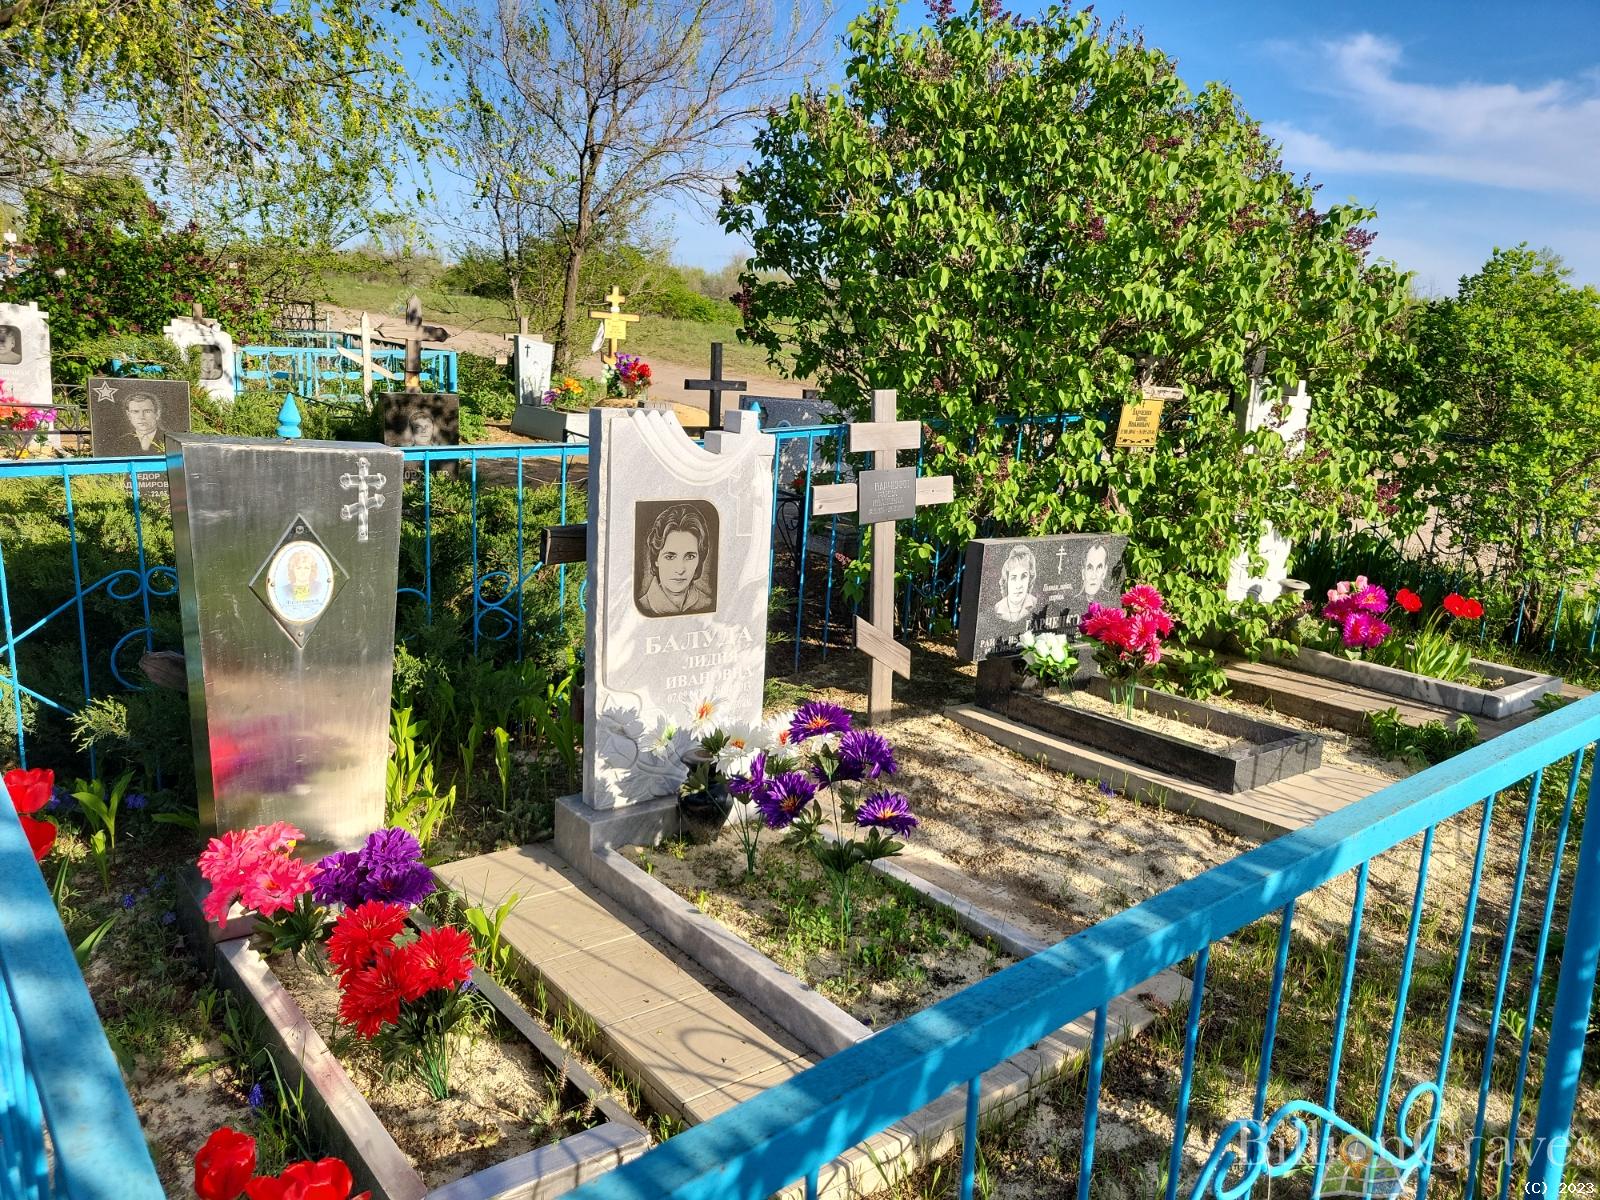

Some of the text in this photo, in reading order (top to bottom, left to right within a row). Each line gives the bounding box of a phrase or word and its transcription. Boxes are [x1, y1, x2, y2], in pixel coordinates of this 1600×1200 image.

[129, 473, 161, 481] ЕДОР
[644, 626, 753, 656] БАЛУДА
[665, 666, 753, 690] ИВАНОВНА
